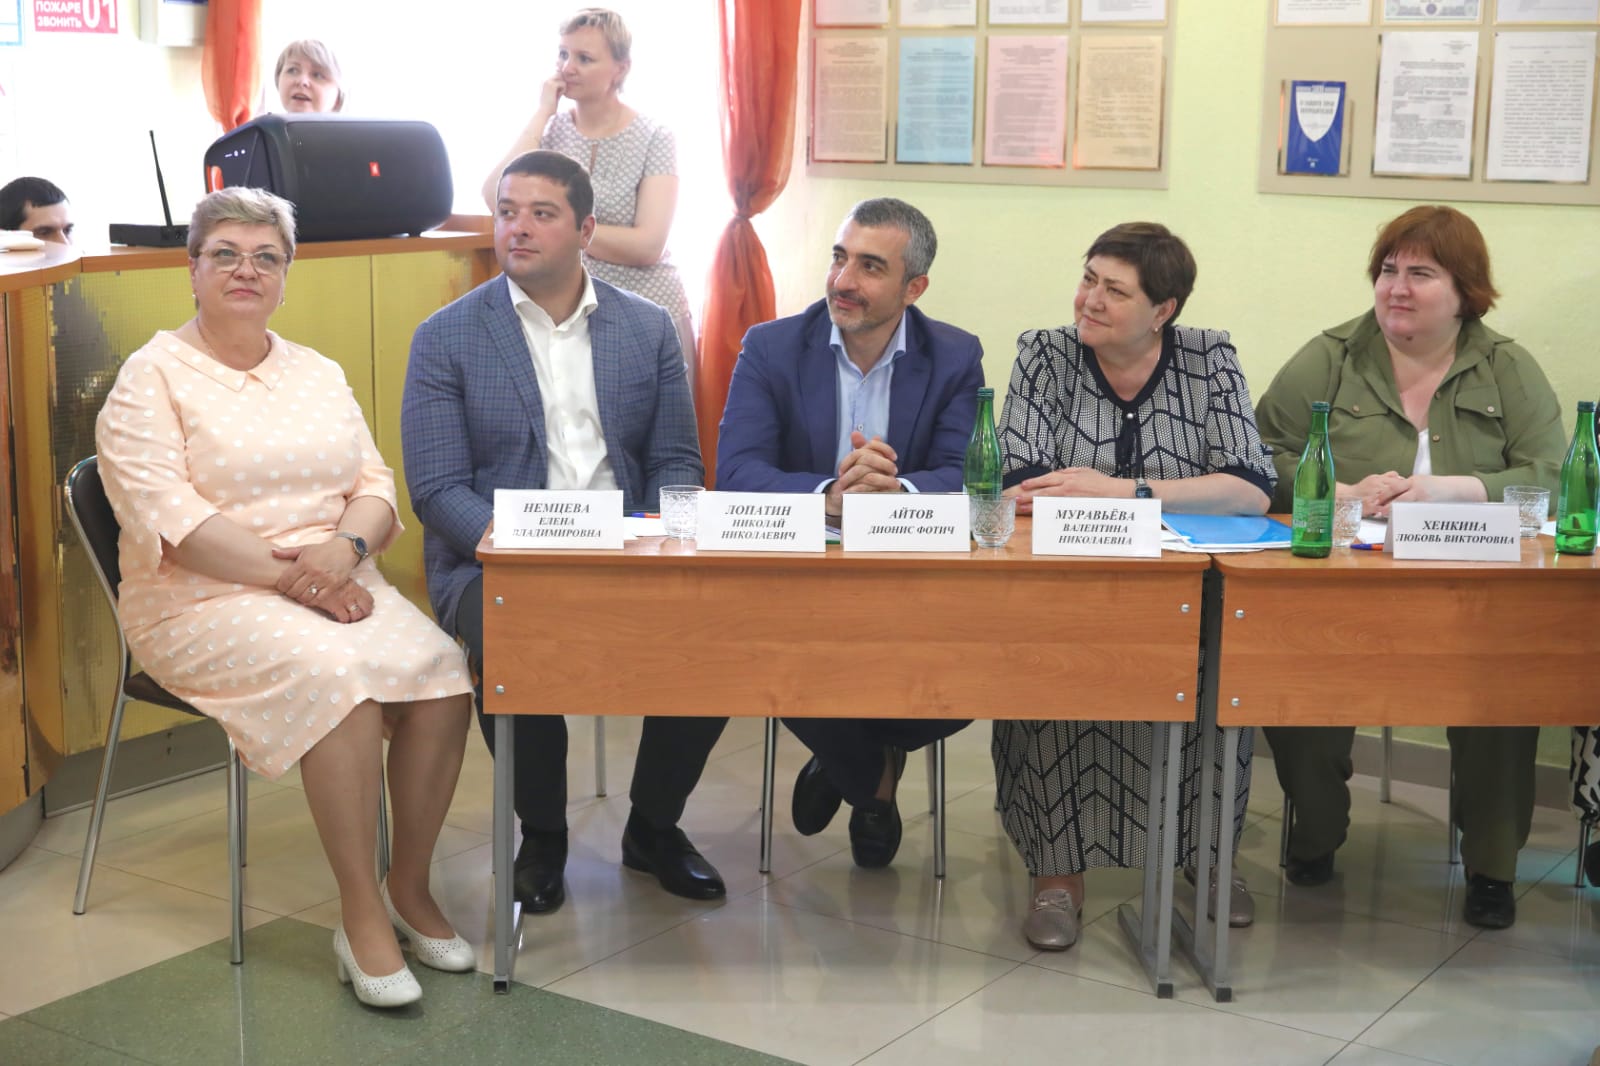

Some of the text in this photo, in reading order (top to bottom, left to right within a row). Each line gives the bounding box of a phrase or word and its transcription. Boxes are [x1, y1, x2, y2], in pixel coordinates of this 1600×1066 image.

[36, 1, 80, 14] ПОЖАРЕ
[83, 0, 116, 29] 01
[37, 16, 82, 28] ЗВОНИТЬ
[523, 502, 590, 514] НЕМЦЕВА
[725, 505, 792, 516] ЛОПАТИН
[889, 506, 934, 519] АЙТОВ
[1056, 508, 1136, 521] МУРАВЬЁВА
[539, 517, 575, 526] ЕЛЕНА
[732, 518, 786, 529] НИКОЛАЙ
[1422, 520, 1487, 531] ХЕНКИНА
[868, 525, 955, 535] ДИОНИС ФОТИЧ
[1063, 523, 1128, 533] ВАЛЕНТИНА
[721, 530, 796, 540] НИКОЛАЕВИЧ
[1058, 535, 1132, 545] НИКОЛАЕВНА
[1396, 533, 1514, 545] ЛЮБОВЬ ВИКТОРОВНА
